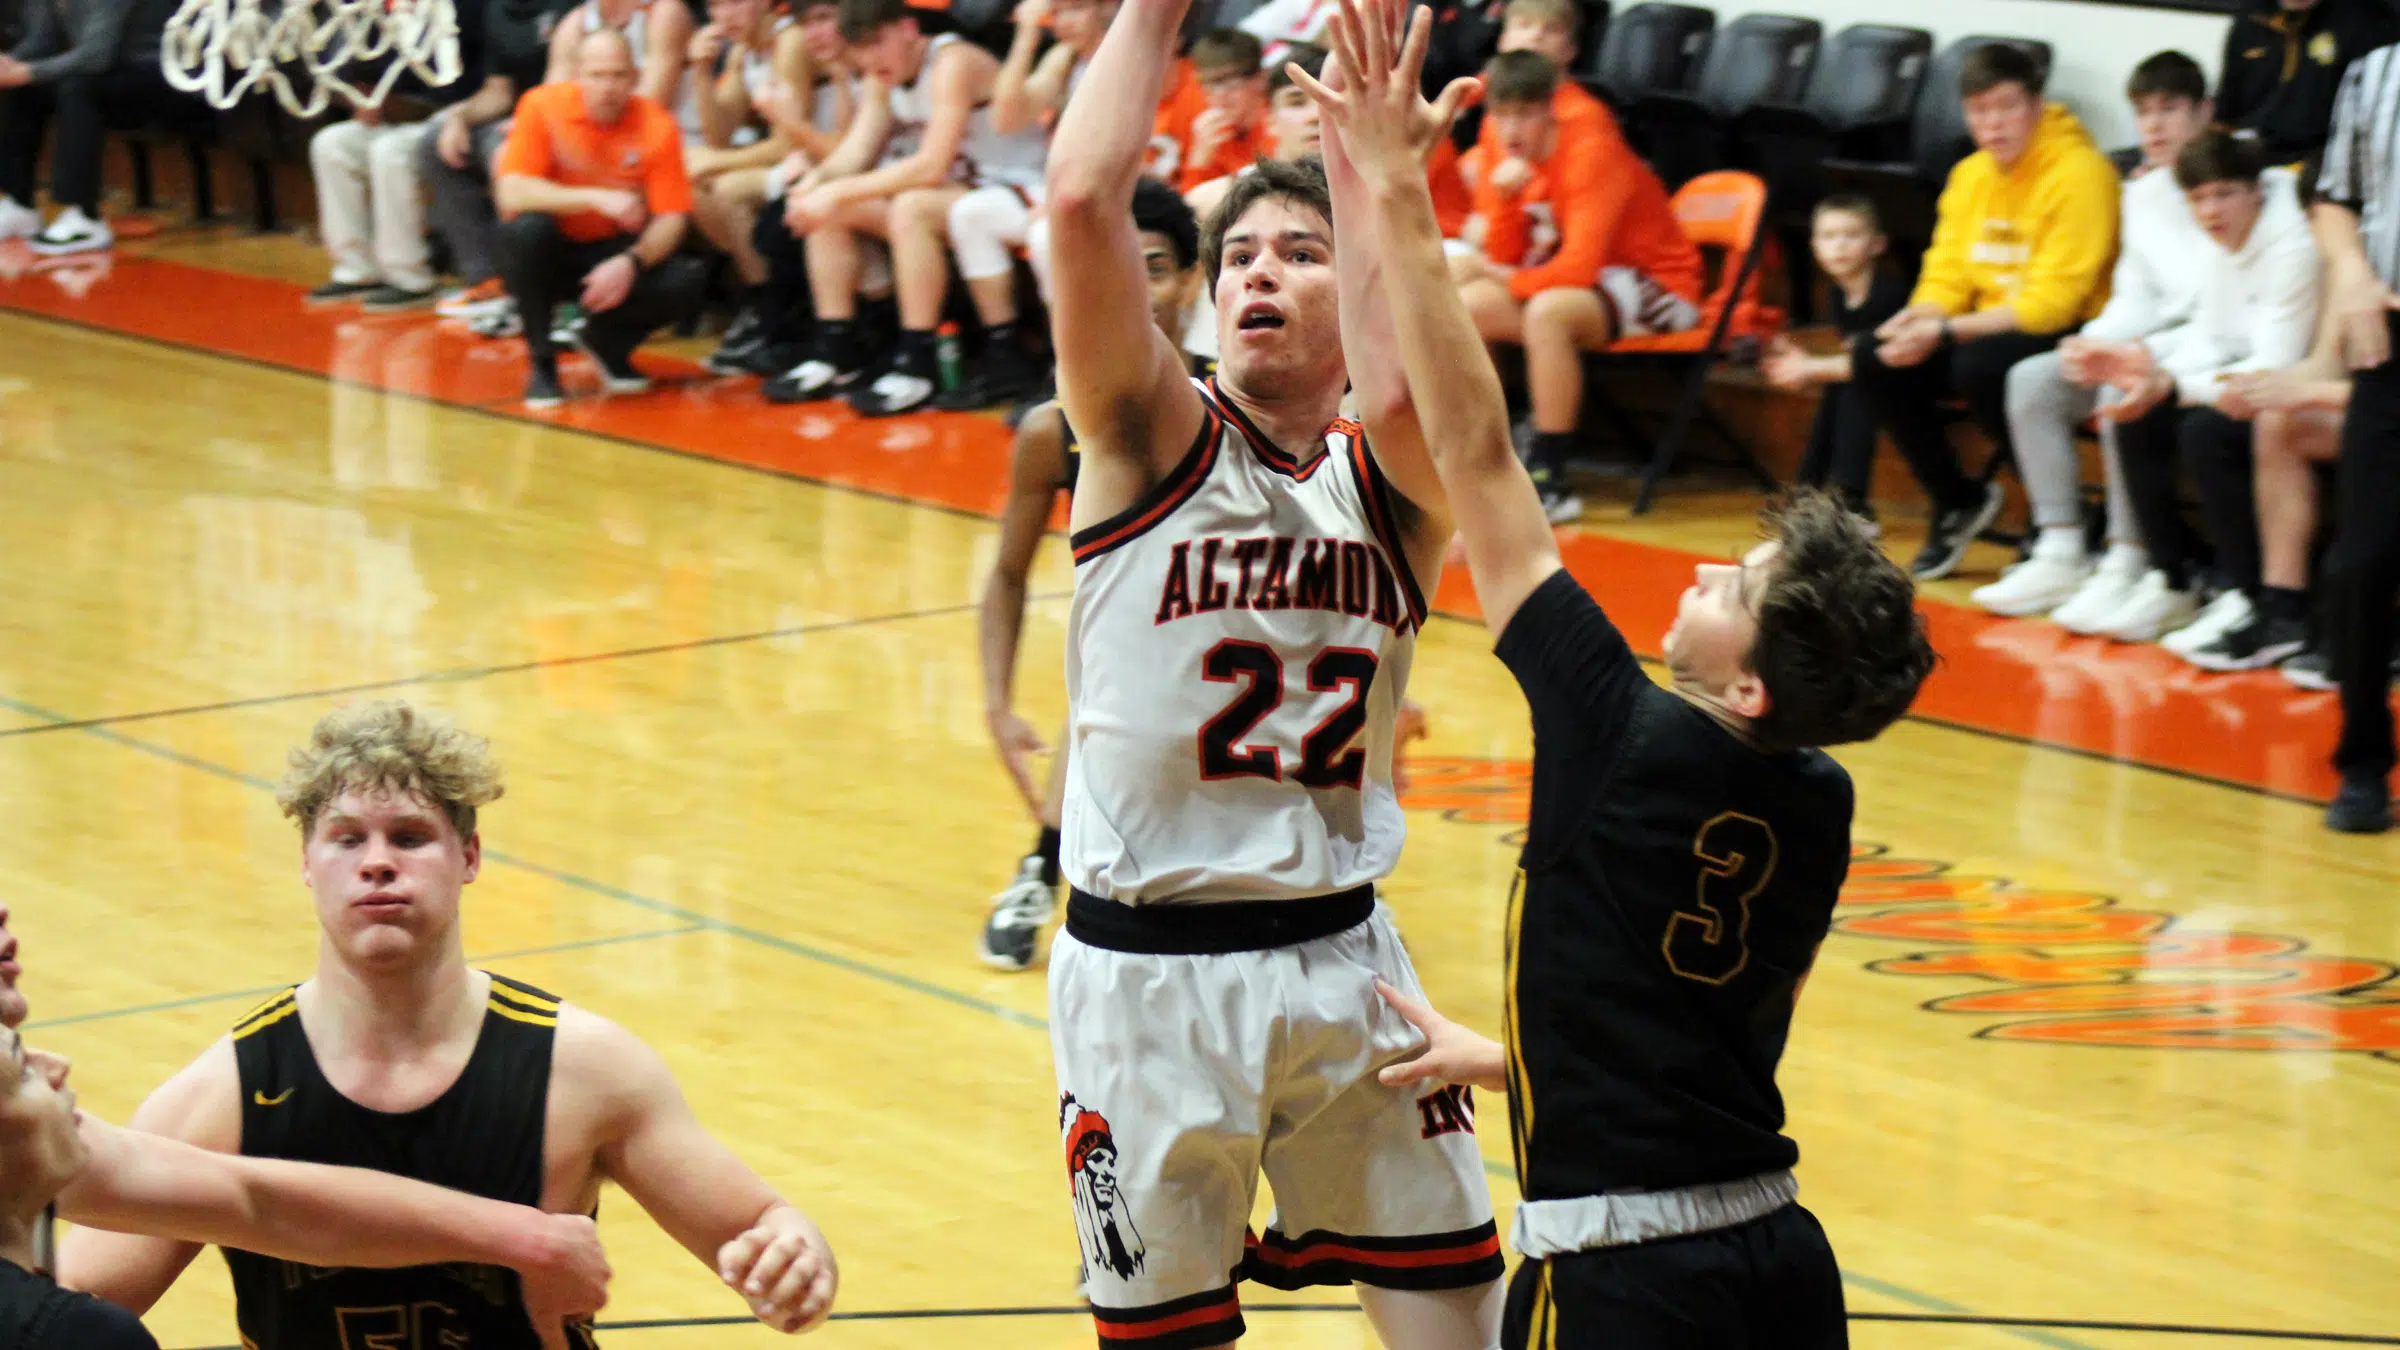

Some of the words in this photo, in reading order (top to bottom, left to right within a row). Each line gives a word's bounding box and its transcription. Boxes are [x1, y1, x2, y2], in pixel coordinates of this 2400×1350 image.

[1154, 537, 1410, 639] ALTAMON
[1198, 637, 1379, 791] 22
[1661, 811, 1779, 986] 3
